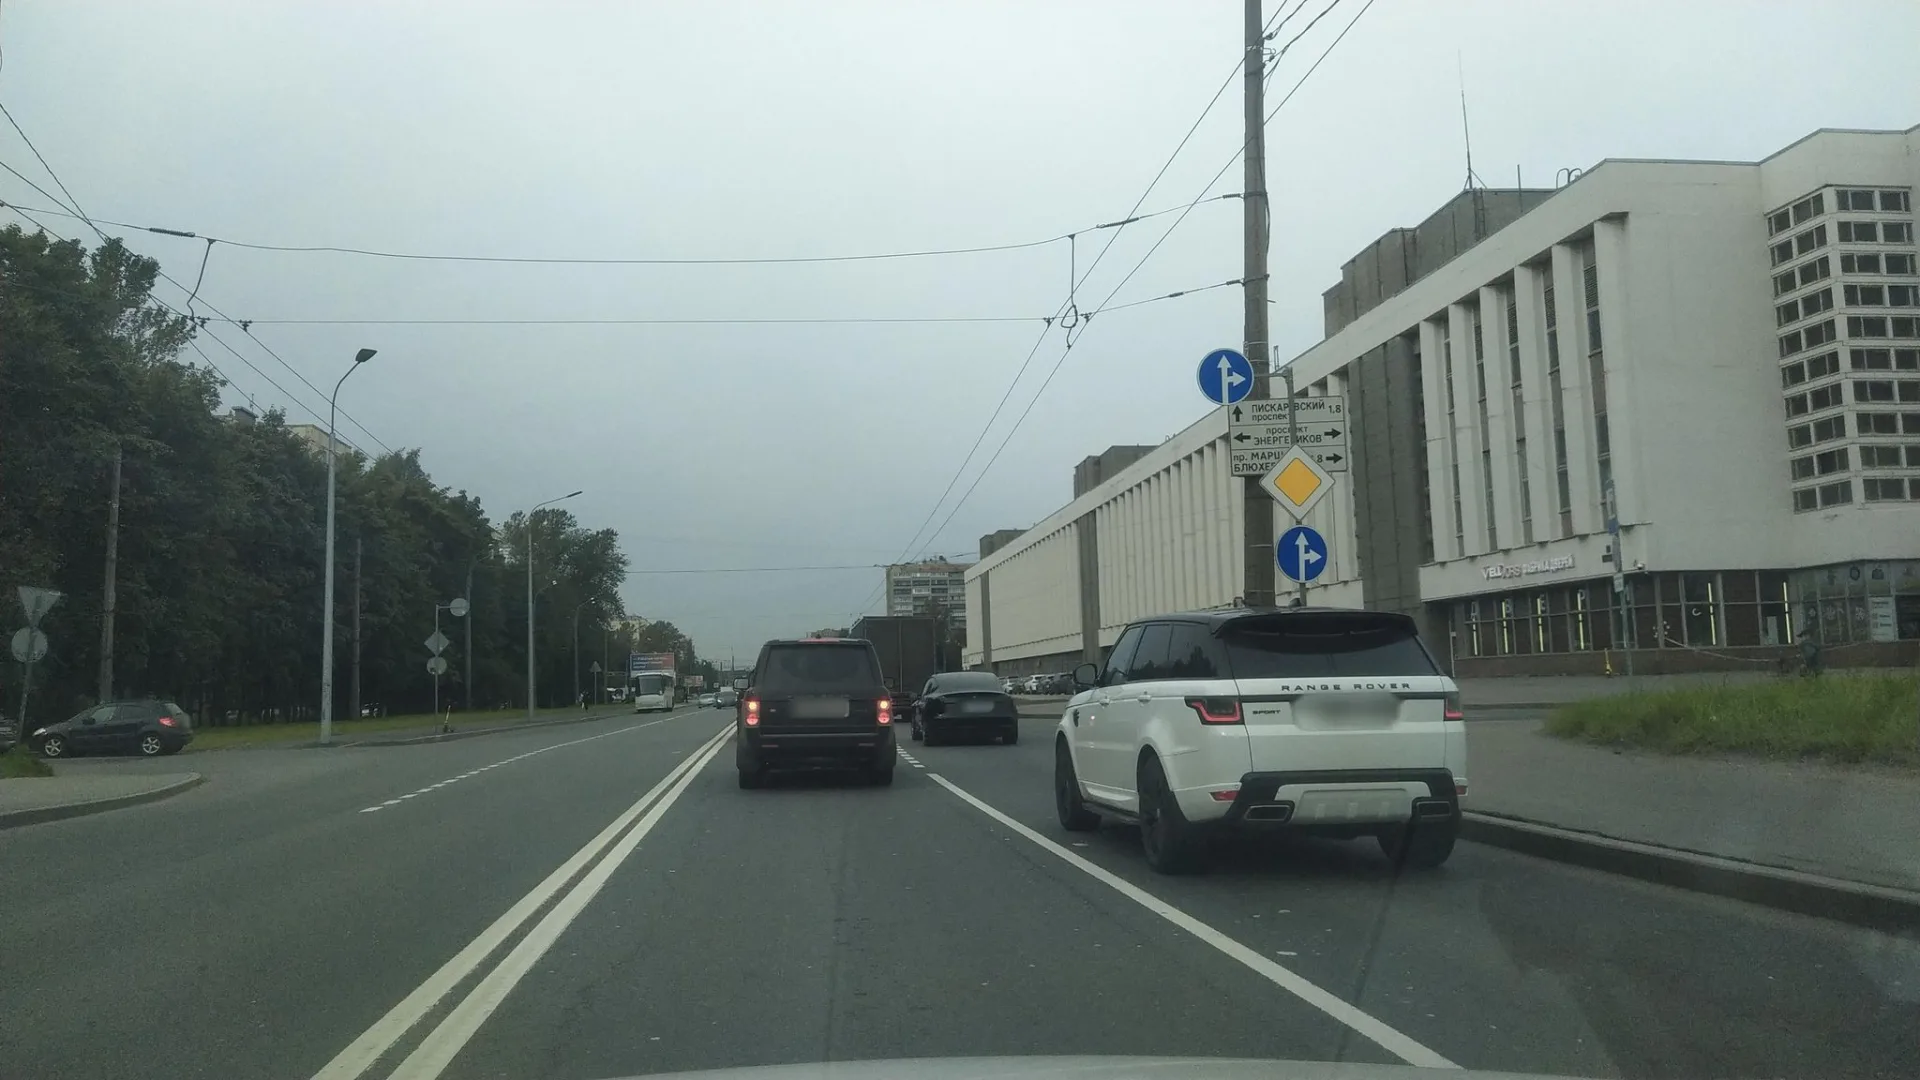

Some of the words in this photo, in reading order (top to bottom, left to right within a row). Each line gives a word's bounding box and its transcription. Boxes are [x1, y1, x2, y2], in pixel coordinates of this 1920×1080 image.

[1251, 399, 1325, 413] ПИСКАРВСКИЙ
[1265, 426, 1308, 435] проскт
[1253, 434, 1322, 446] ЭНЕРГЕИКОВ
[1234, 461, 1276, 473] БЛЮХЕ
[1281, 683, 1341, 692] RANGE
[1354, 682, 1411, 690] ROVER
